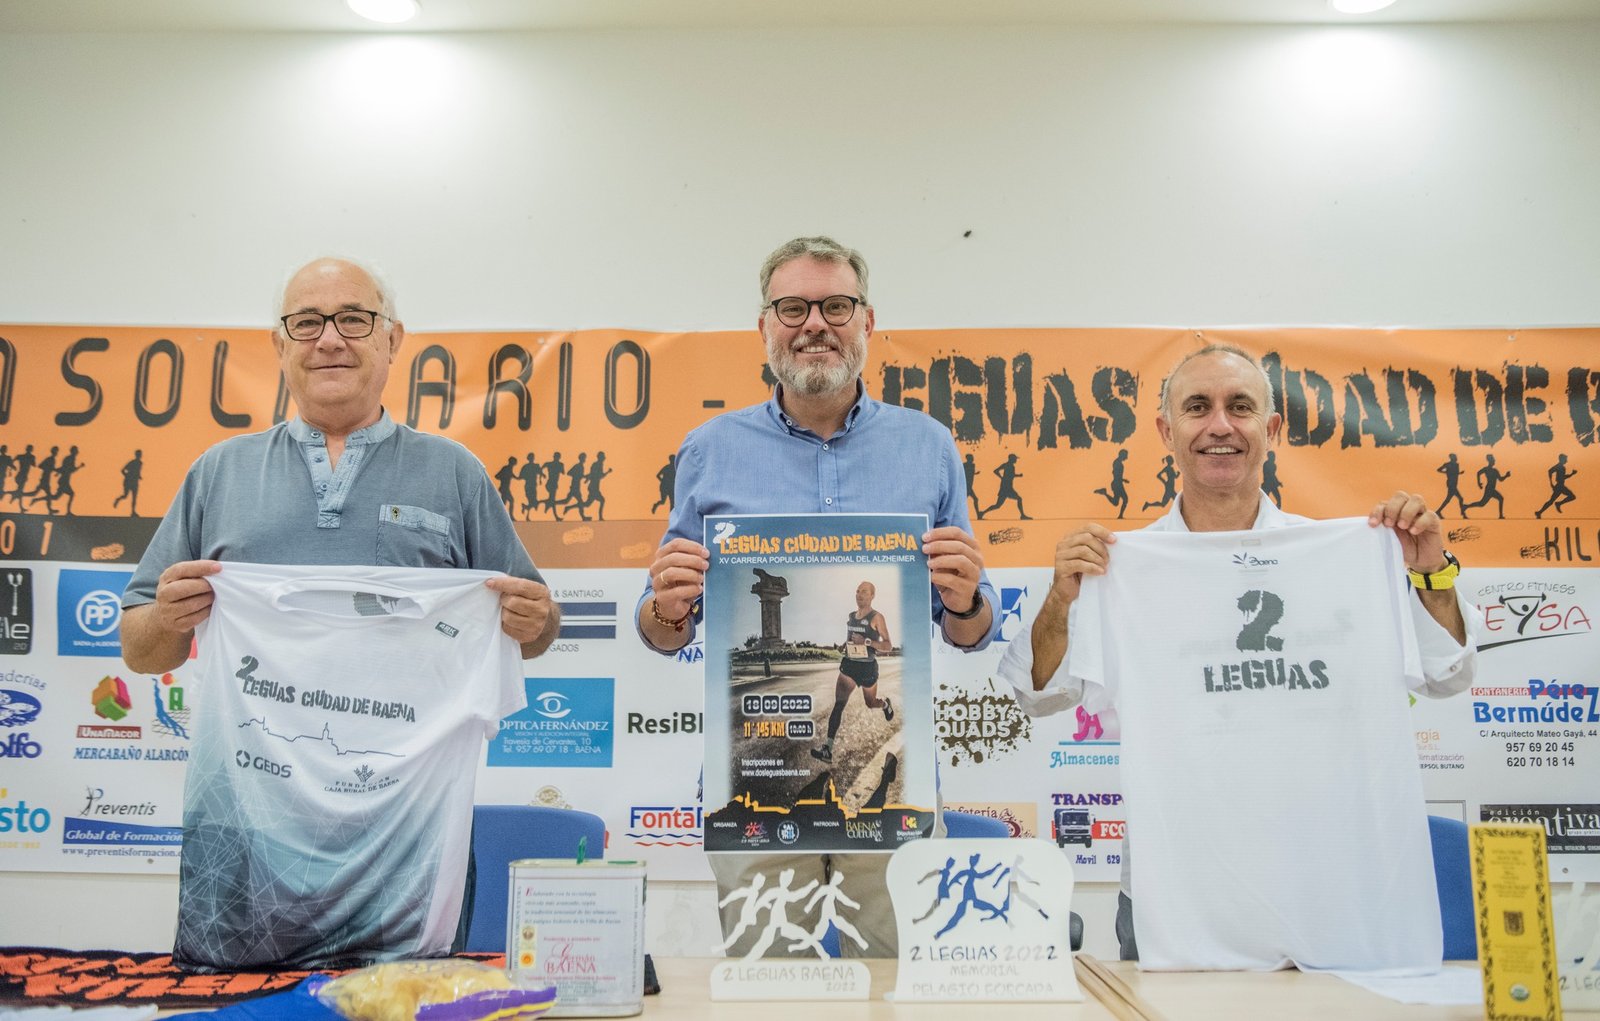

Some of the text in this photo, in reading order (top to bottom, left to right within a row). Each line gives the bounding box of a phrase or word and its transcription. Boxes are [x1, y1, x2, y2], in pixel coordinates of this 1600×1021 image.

[881, 349, 1141, 451] EGUAS
[1450, 359, 1554, 446] DE
[712, 521, 737, 545] 2
[719, 531, 918, 555] LEGUAS CIUDAD DE BAENA
[1544, 527, 1600, 562] KIL
[719, 557, 728, 565] XV
[730, 556, 768, 564] CARRERA
[769, 556, 805, 564] POPULAR
[806, 555, 819, 564] DÍA
[872, 555, 916, 563] ALZHEIMER
[561, 589, 604, 598] SANTIAGO
[1478, 582, 1576, 596] CENTRO FITNESS
[85, 605, 115, 625] PP
[1235, 589, 1285, 652] 2
[549, 643, 579, 652] GADOS
[235, 655, 259, 681] 2
[1203, 657, 1330, 693] LEGUAS
[242, 678, 416, 722] LEGUAS CIUDAD DE BAENA
[745, 699, 810, 710] 18 09 2022
[935, 703, 1011, 721] HOBBY
[540, 719, 609, 731] FERNÁNDEZ
[770, 721, 785, 737] KM
[935, 722, 1011, 738] QUADS
[1491, 730, 1535, 739] Arquitecto
[1537, 730, 1561, 738] Mateo
[1563, 729, 1586, 739] Gayá,
[515, 745, 532, 753] 957
[533, 745, 544, 753] 69
[545, 745, 557, 753] 07
[560, 745, 569, 753] 18
[582, 738, 592, 746] 10
[1506, 742, 1575, 752] 957 69 20 45
[73, 745, 142, 760] MERCABAÑO
[1050, 752, 1120, 768] Almacenes
[253, 756, 293, 779] GEDS
[741, 758, 776, 768] Inscripciones
[1506, 757, 1575, 767] 620 70 18 14
[1051, 793, 1124, 806] TRANSP
[66, 829, 105, 840] Global
[106, 830, 121, 840] de
[845, 822, 877, 833] BAENA
[1107, 854, 1121, 864] 629
[910, 945, 1058, 962] 2 LEGUAS 2022
[723, 966, 856, 982] 2 LEGUAS BAENA
